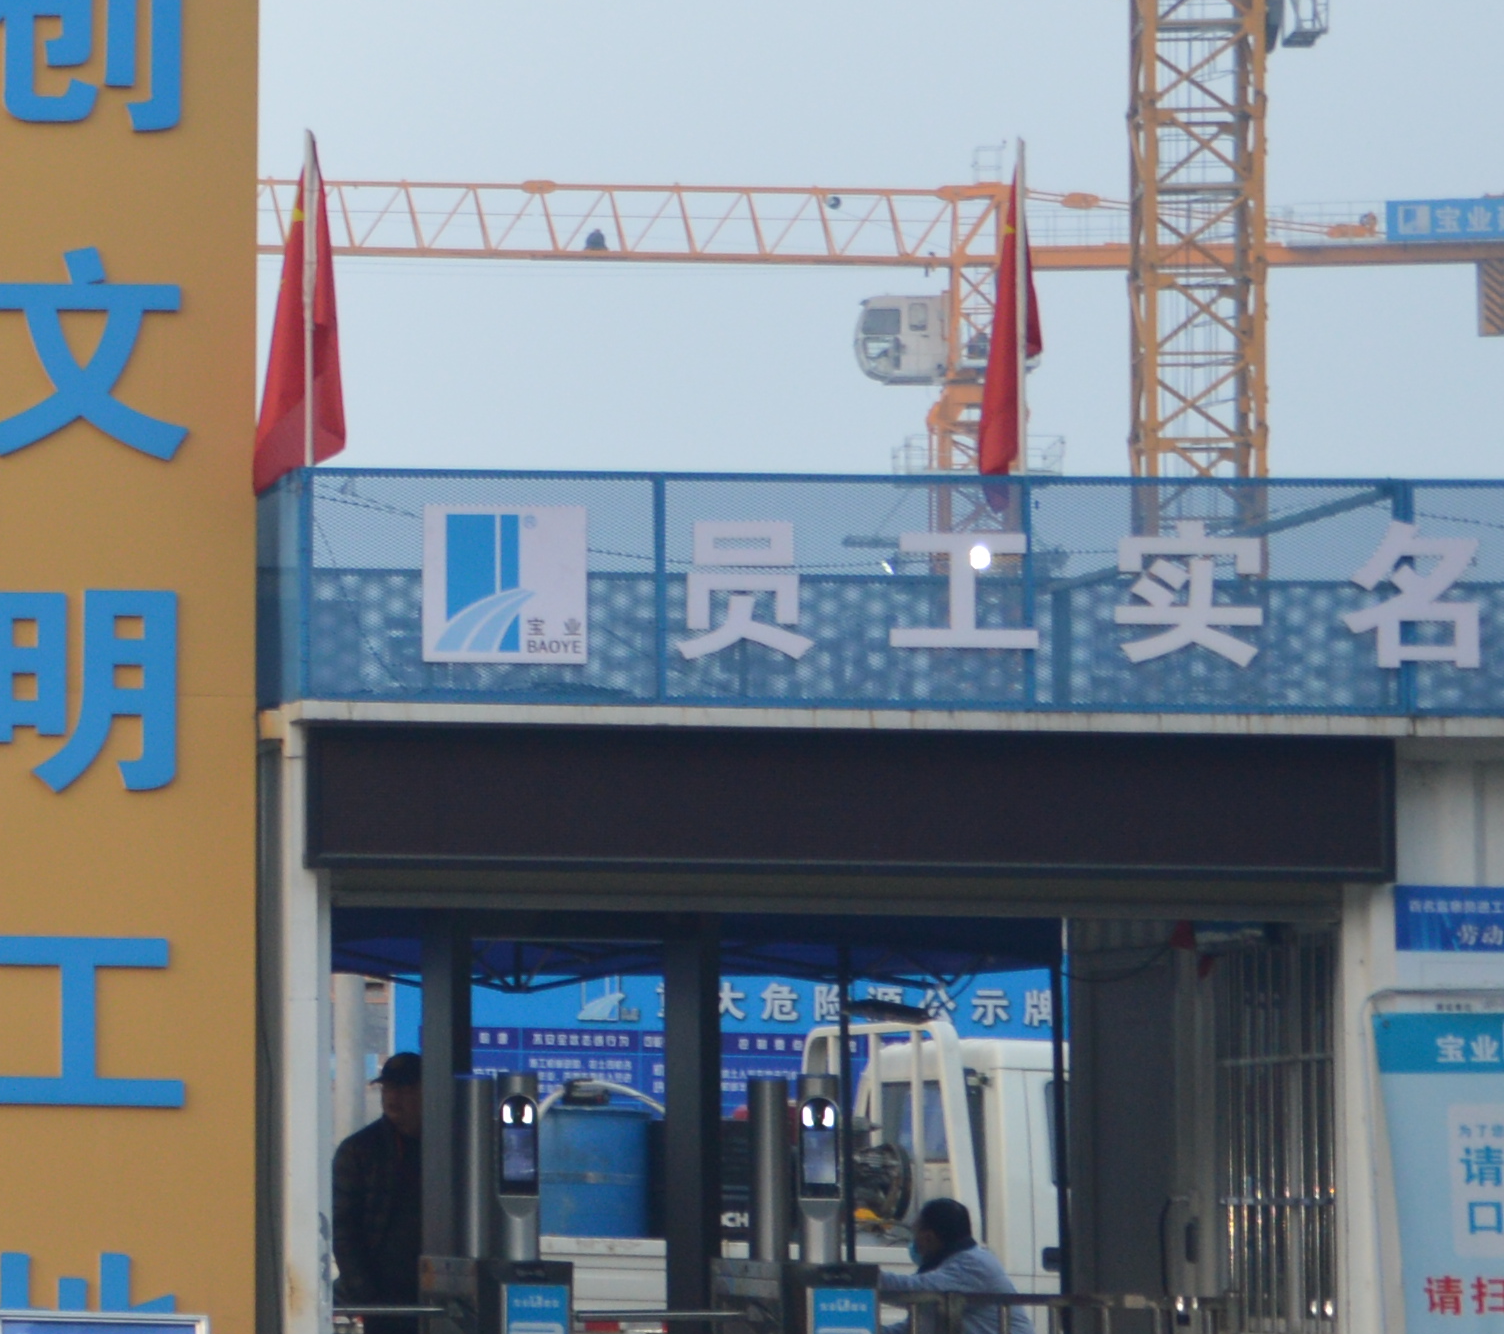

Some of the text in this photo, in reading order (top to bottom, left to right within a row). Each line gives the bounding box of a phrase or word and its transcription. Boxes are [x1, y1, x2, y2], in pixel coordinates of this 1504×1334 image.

[1435, 205, 1504, 234] 宝业
[676, 520, 1480, 669] 员工实名
[527, 617, 583, 637] 宝业
[527, 640, 583, 655] BAOYE
[1436, 1033, 1501, 1063] 宝业
